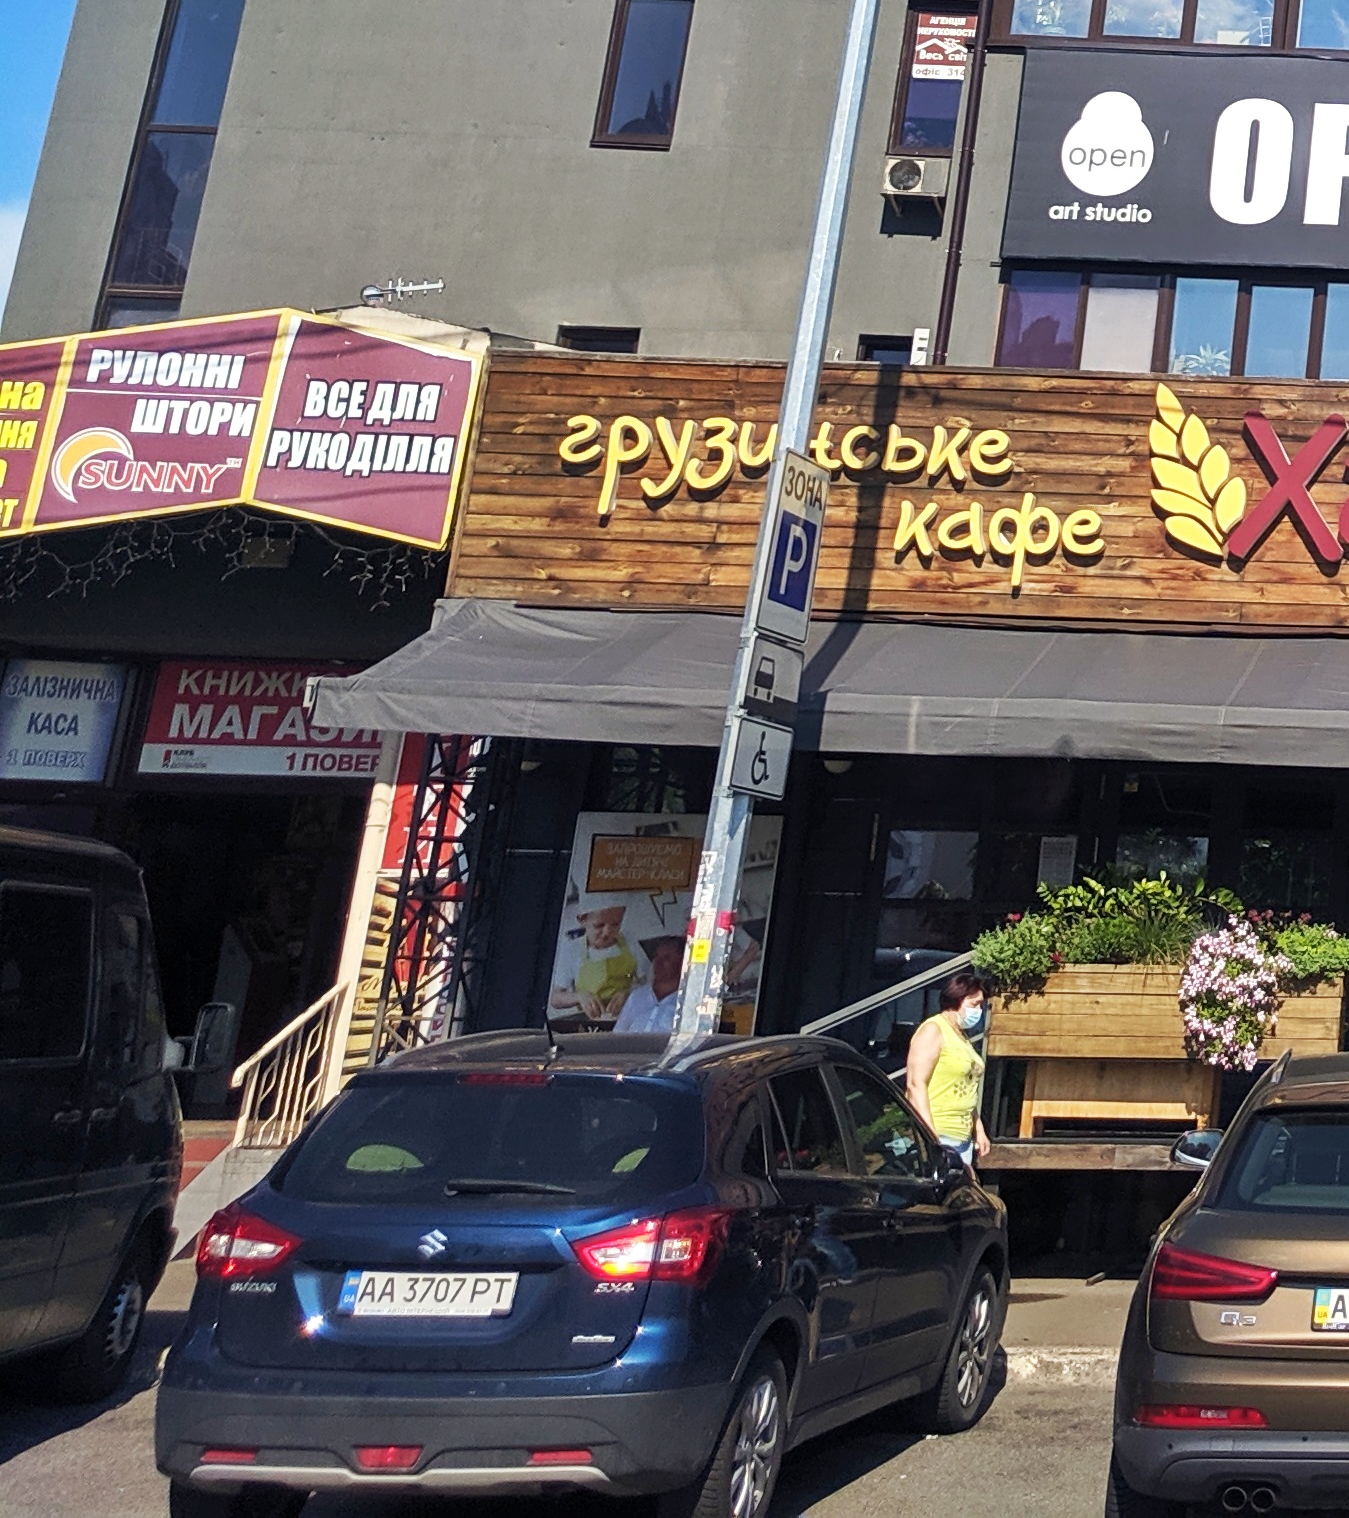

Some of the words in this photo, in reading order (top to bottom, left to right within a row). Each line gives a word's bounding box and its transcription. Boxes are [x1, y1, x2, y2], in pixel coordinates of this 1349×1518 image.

[1069, 147, 1146, 172] open
[1048, 202, 1081, 220] art
[1084, 202, 1153, 223] studio
[86, 348, 246, 390] РУЛОННІ
[303, 380, 366, 421] ВСЕ
[366, 381, 442, 425] ДЛЯ
[130, 398, 257, 438] ШТОРИ
[267, 430, 456, 477] РУКОДІЛЛЯ
[78, 457, 229, 493] SUNNY
[784, 466, 823, 511] ЗОНА
[894, 492, 1106, 587] кафе
[6, 674, 118, 703] ЗАЛІЗНИЧНА
[26, 711, 80, 737] КАСА
[23, 750, 86, 769] ПОВЕРХ
[286, 752, 296, 771] 1
[358, 1277, 395, 1304] AA
[402, 1277, 467, 1304] 3707
[470, 1278, 512, 1304] PT
[594, 1282, 635, 1293] SX4
